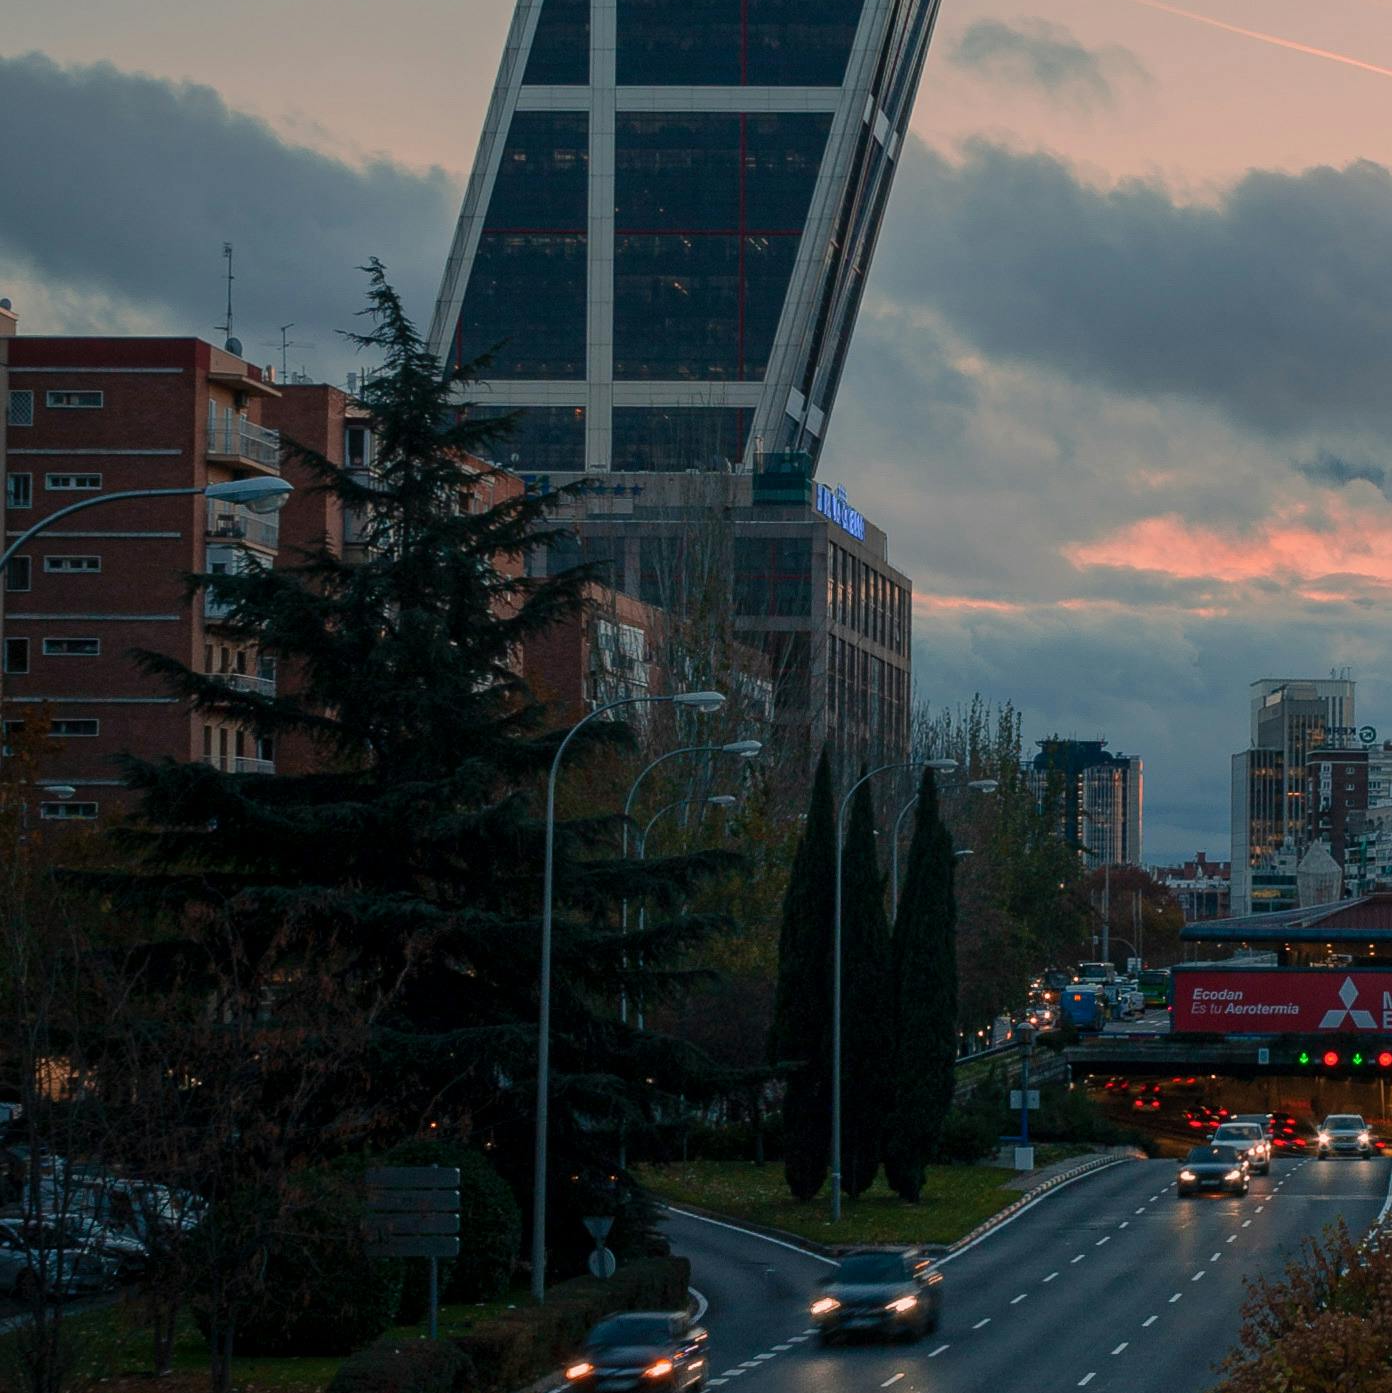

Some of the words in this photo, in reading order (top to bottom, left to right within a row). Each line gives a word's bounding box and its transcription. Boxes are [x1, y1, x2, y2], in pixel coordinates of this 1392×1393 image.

[1192, 987, 1244, 1001] Ecodan
[1191, 1001, 1207, 1014] Es
[1210, 1003, 1223, 1014] tu
[1224, 1002, 1300, 1015] Aerotermia
